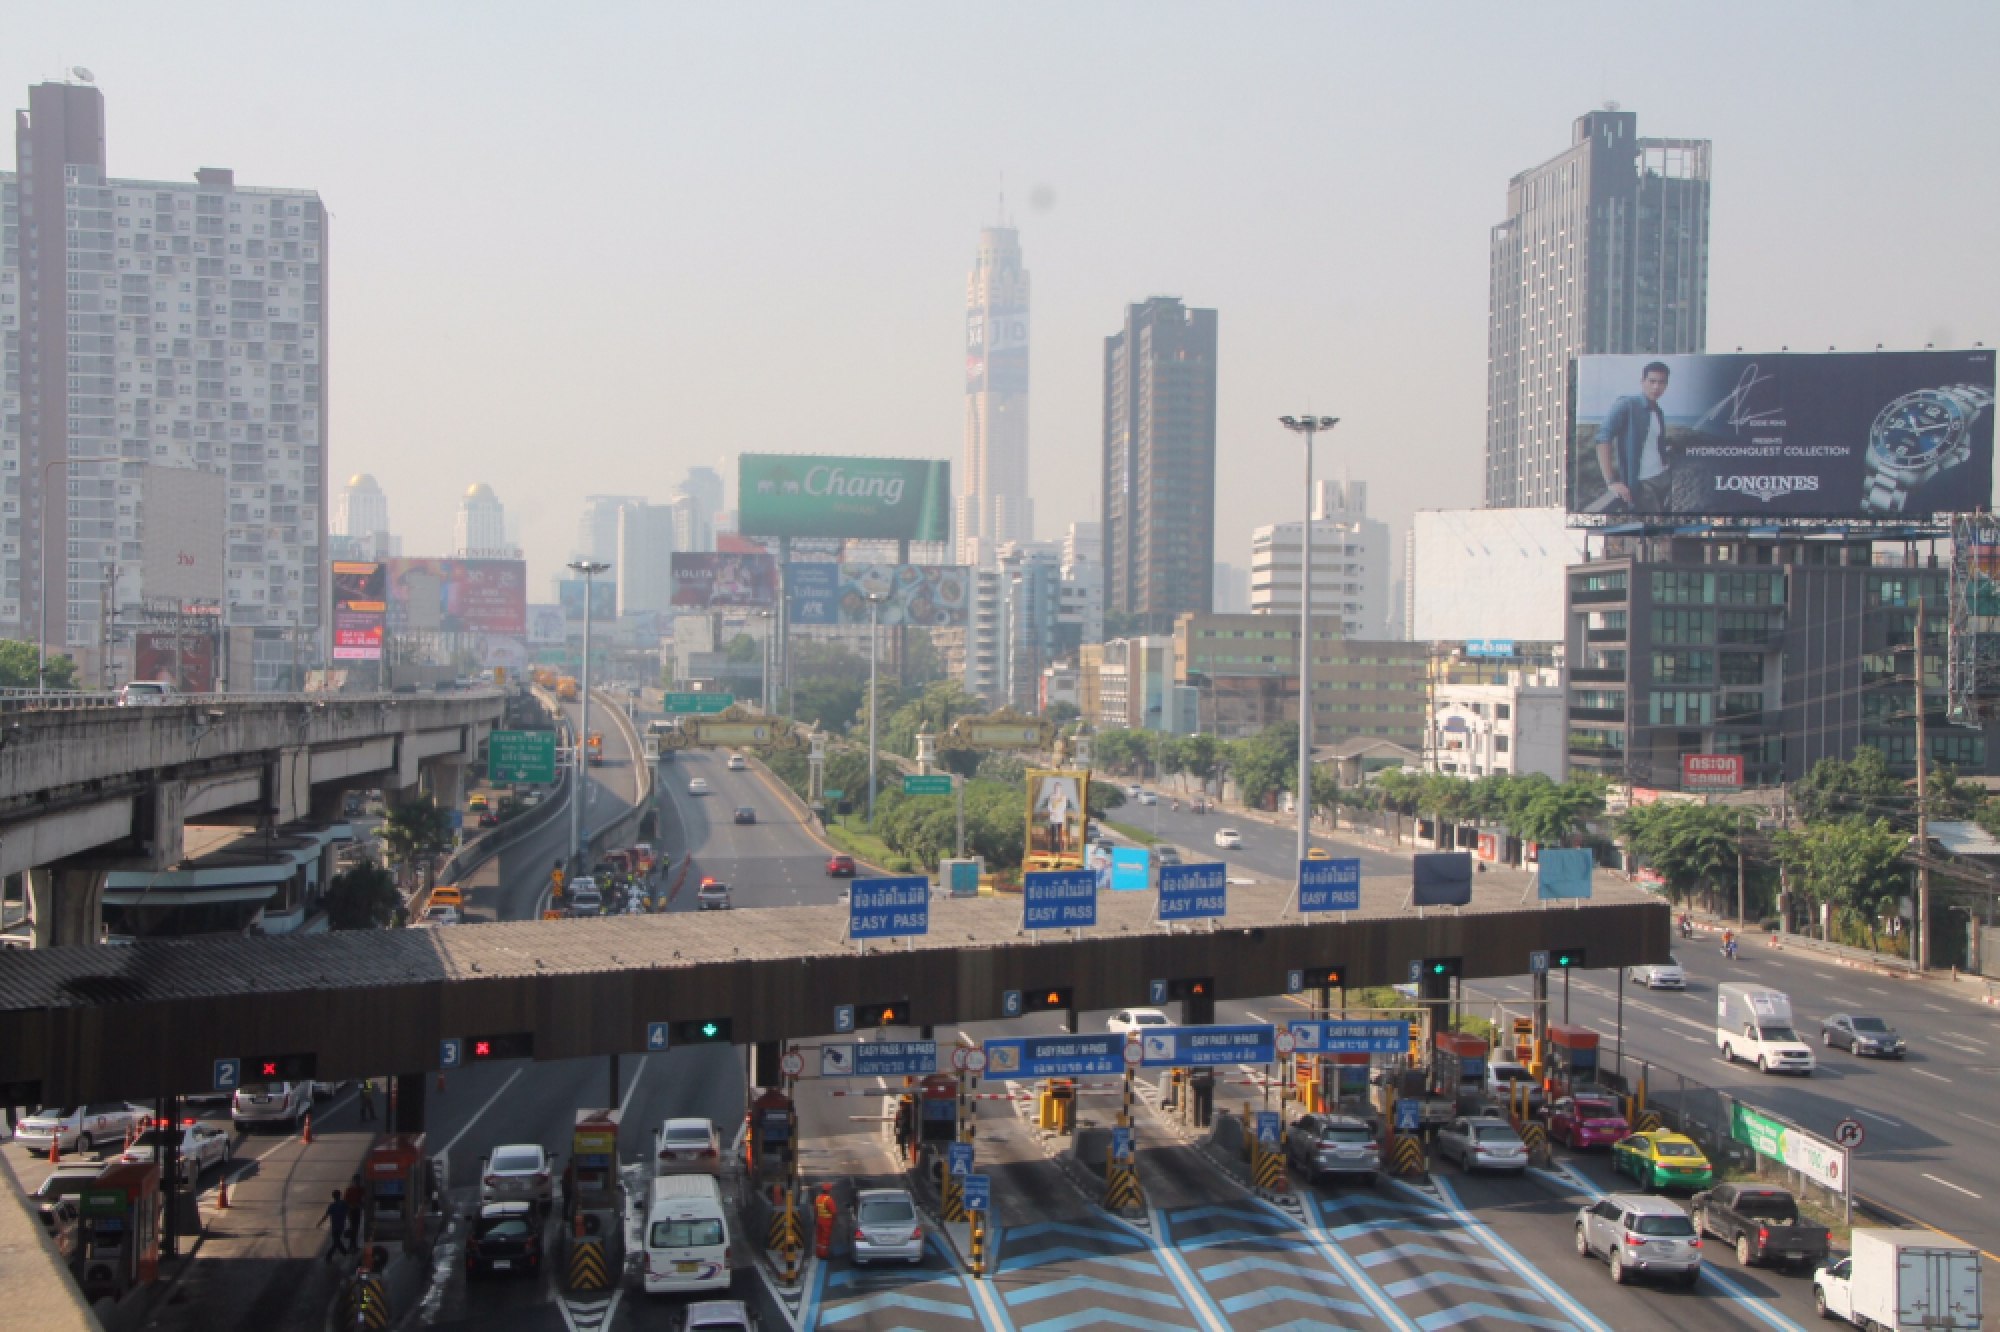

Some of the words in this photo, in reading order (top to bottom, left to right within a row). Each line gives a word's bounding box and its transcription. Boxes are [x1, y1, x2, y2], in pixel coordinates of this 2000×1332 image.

[1686, 446, 1781, 457] HYDROCONQUEST
[1783, 445, 1850, 456] COLLECTION
[804, 465, 905, 505] Chang
[1715, 475, 1819, 491] LONGINES
[674, 569, 713, 579] LOLITA
[1690, 758, 1736, 770] กระจก
[1161, 898, 1192, 913] EASY
[1195, 896, 1224, 910] PASS
[1302, 891, 1327, 905] EASY
[1332, 890, 1357, 904] PASS
[1027, 906, 1058, 922] EASY
[1063, 904, 1093, 919] PASS
[852, 914, 888, 931] EASY
[893, 912, 926, 928] PASS
[1533, 953, 1546, 969] 10
[1412, 963, 1420, 979] 9
[1290, 974, 1299, 989] 8
[1154, 984, 1163, 1000] 7
[1008, 995, 1017, 1012] 6
[839, 1010, 849, 1027] 5
[652, 1028, 663, 1043] 4
[1330, 1026, 1347, 1037] EASY
[1348, 1026, 1367, 1036] PASS
[1192, 1035, 1209, 1046] EASY
[1210, 1034, 1227, 1045] PASS
[1374, 1041, 1381, 1049] 4
[444, 1044, 456, 1063] 3
[859, 1044, 879, 1056] EASY
[880, 1044, 899, 1055] PASS
[1036, 1045, 1055, 1058] EASY
[1056, 1044, 1075, 1055] PASS
[1235, 1052, 1241, 1060] 4
[908, 1060, 916, 1070] 4
[1085, 1061, 1094, 1070] 4
[219, 1064, 234, 1086] 2
